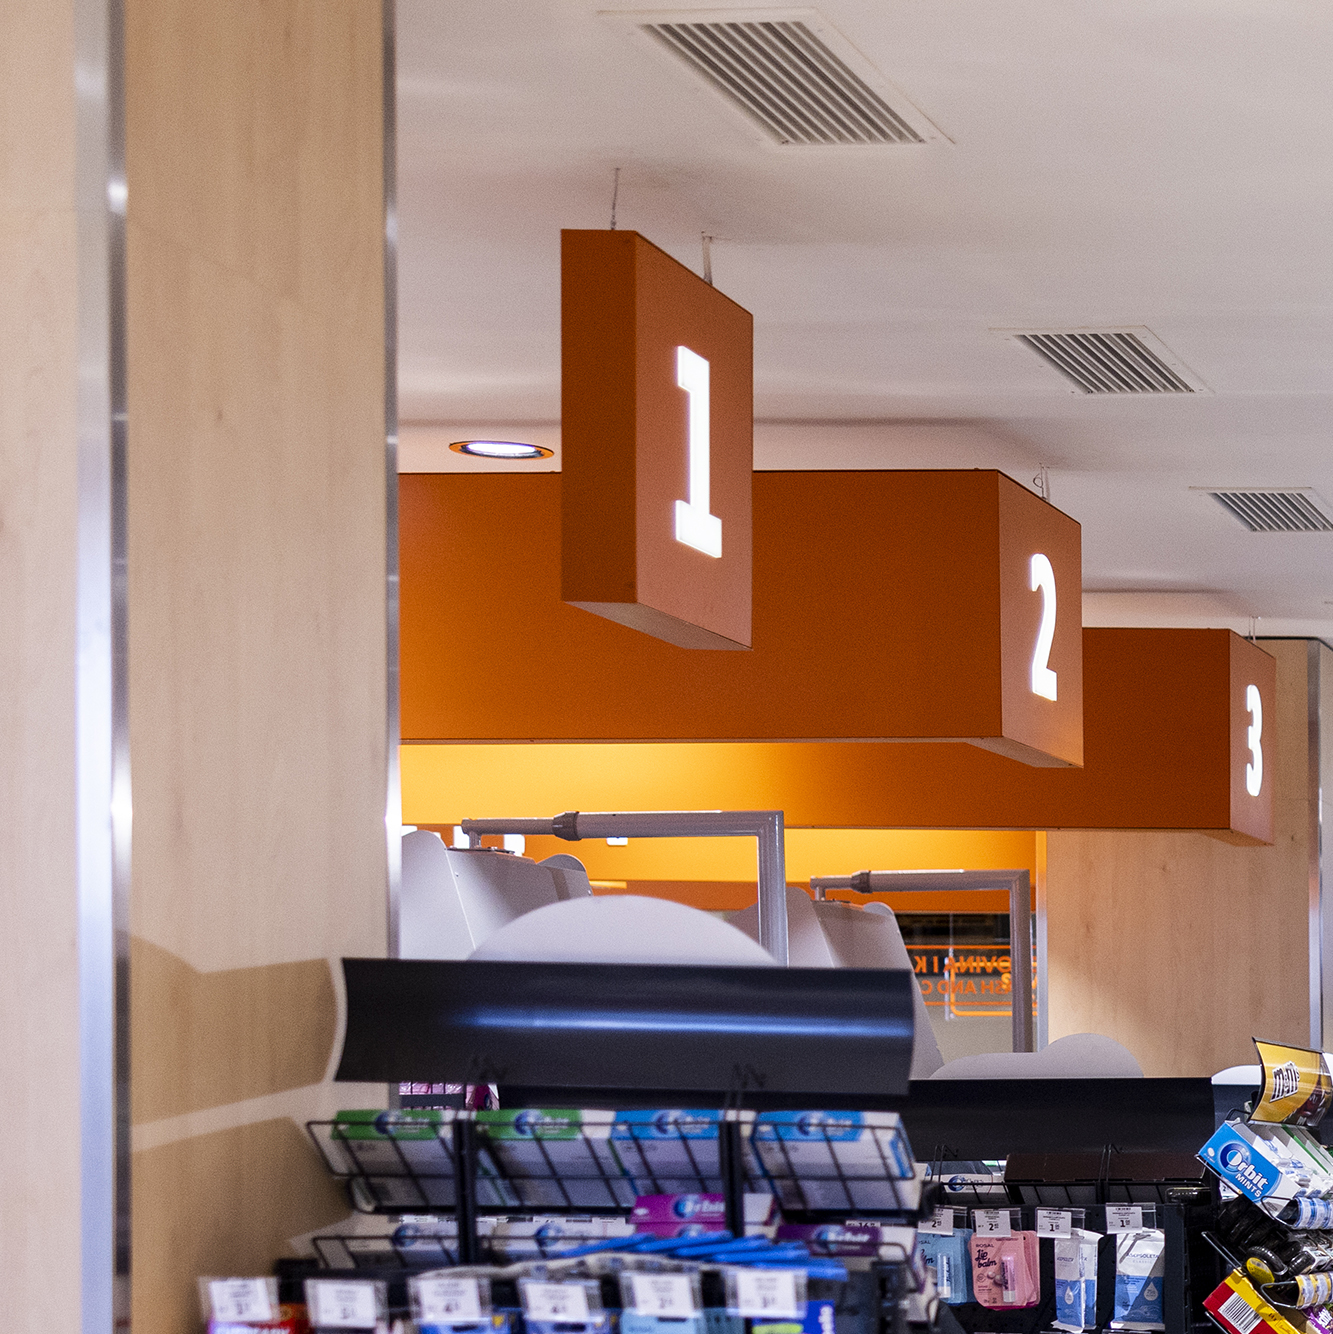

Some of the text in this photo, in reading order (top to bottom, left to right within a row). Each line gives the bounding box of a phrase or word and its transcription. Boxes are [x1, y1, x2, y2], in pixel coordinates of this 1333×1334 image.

[675, 345, 722, 558] 1
[1031, 553, 1057, 702] 2
[1246, 684, 1263, 797] 3
[1235, 1173, 1262, 1198] MINTS
[977, 1259, 997, 1268] balm
